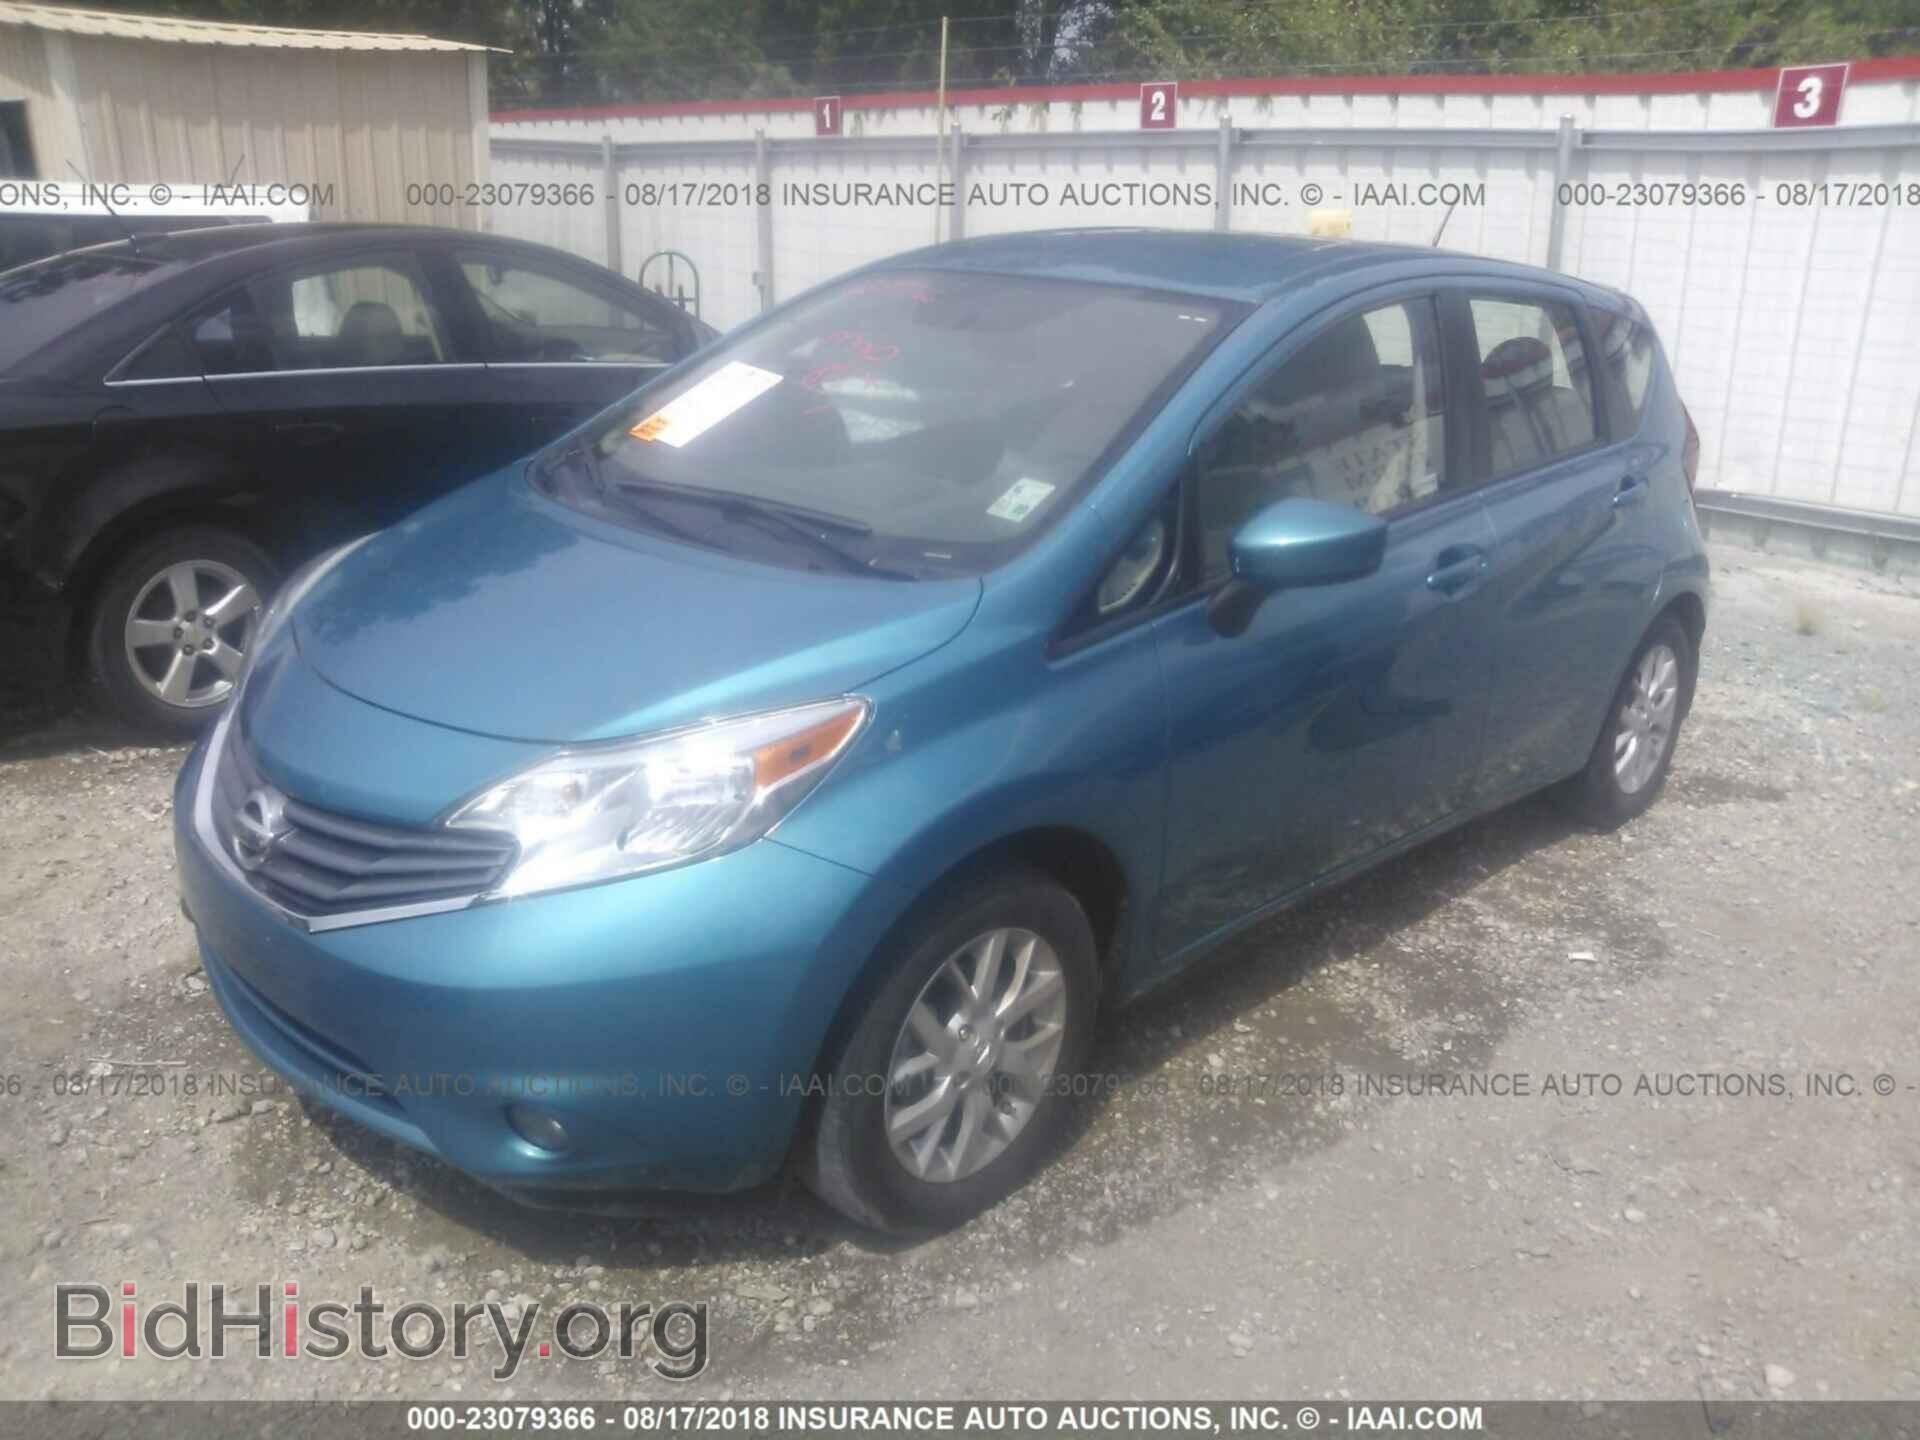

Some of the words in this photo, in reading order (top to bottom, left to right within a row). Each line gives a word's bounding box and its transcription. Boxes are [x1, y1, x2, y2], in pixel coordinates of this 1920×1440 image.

[1151, 91, 1165, 120] 2
[1794, 77, 1823, 118] 3
[823, 103, 830, 128] 1
